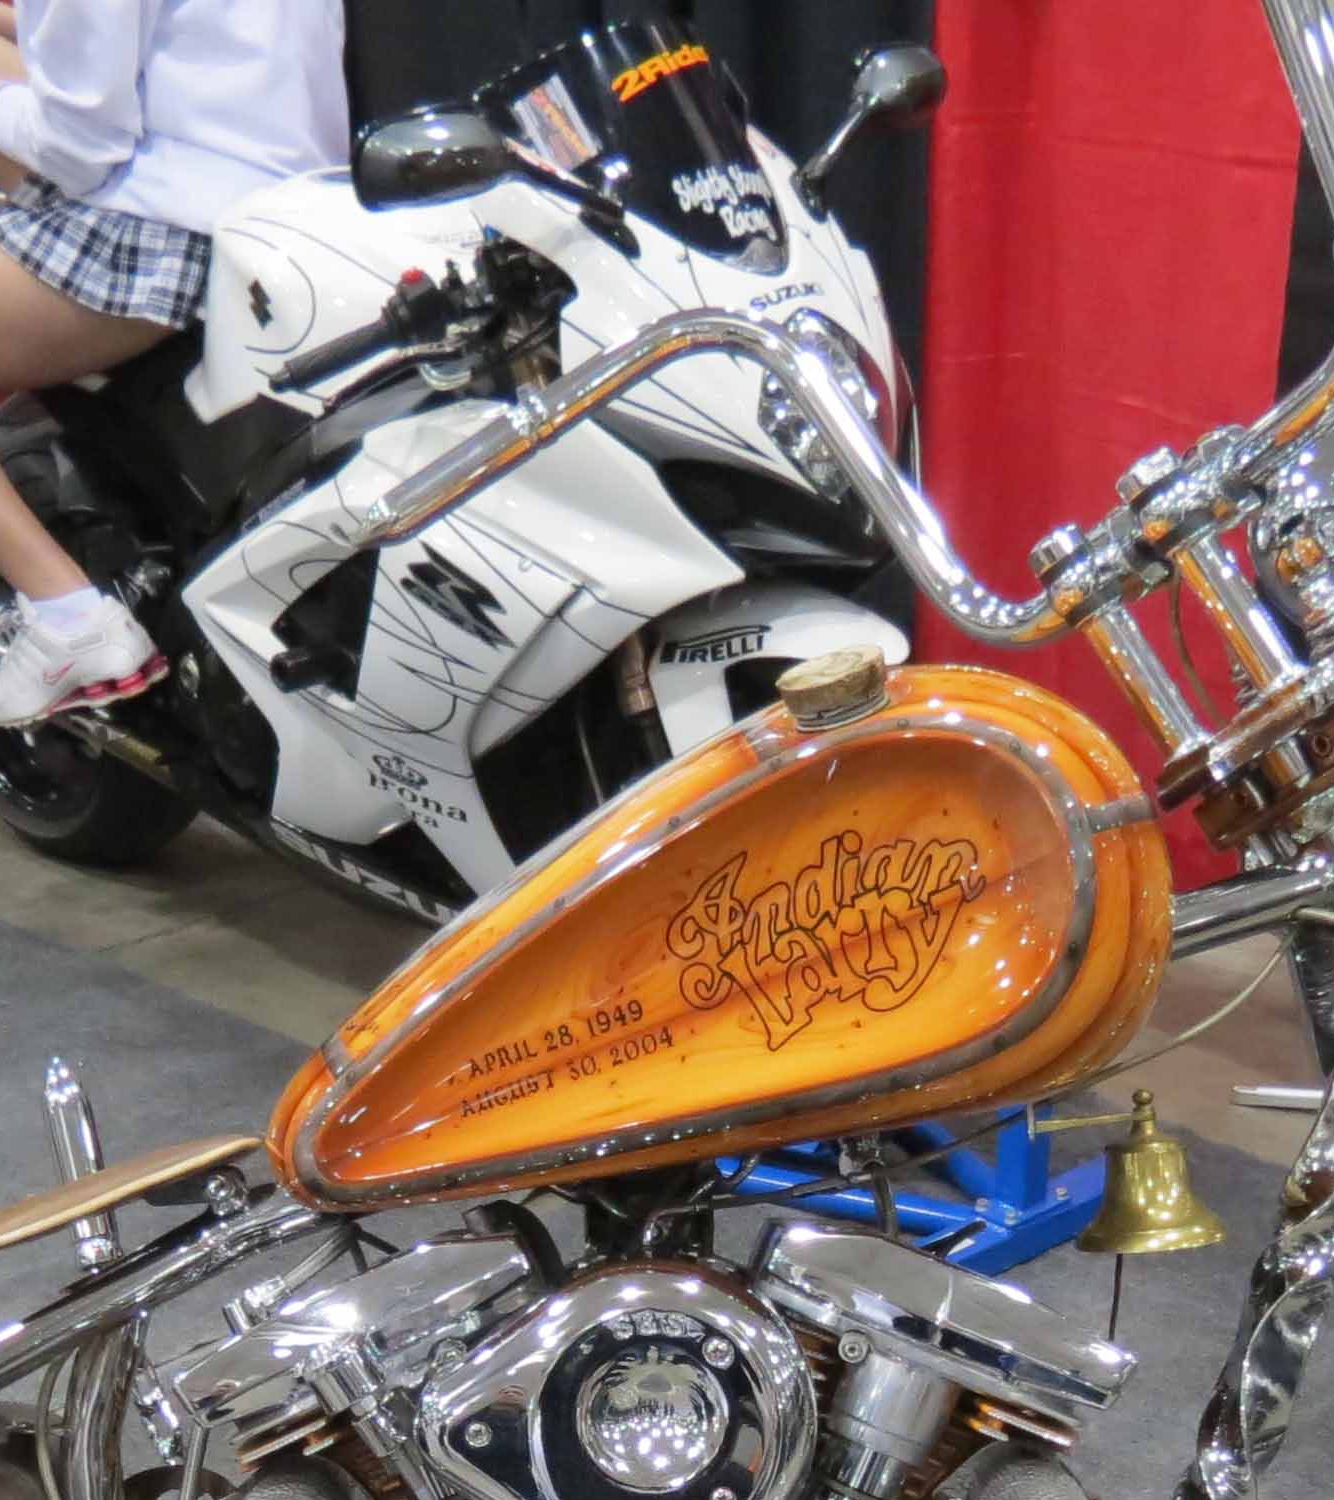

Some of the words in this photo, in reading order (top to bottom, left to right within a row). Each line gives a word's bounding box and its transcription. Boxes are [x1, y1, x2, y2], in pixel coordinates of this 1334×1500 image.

[273, 820, 454, 925] SUZU
[469, 1039, 539, 1081] APRIL
[586, 999, 644, 1038] 1949
[609, 1025, 675, 1068] 2004
